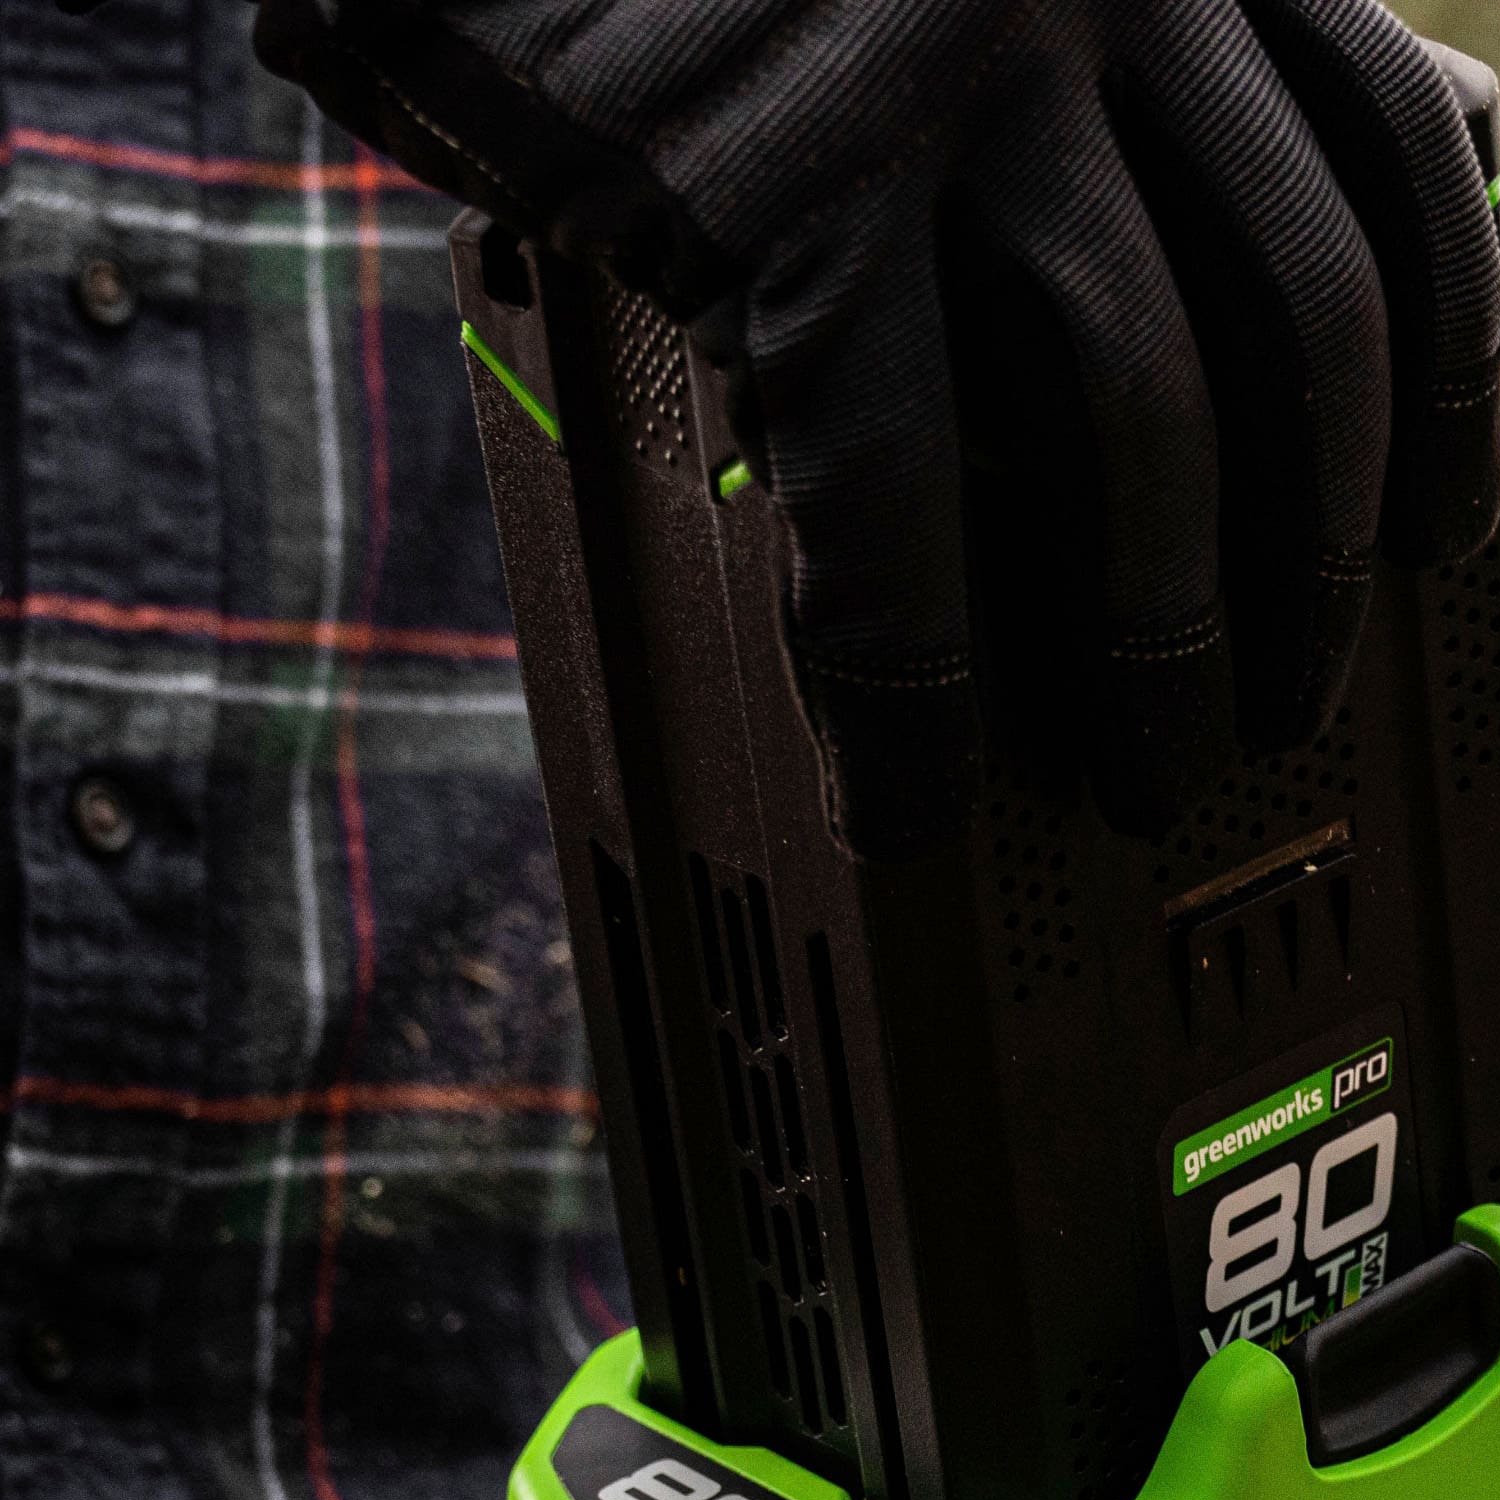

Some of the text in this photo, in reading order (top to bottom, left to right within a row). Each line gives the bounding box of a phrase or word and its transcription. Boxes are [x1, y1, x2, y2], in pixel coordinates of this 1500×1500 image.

[1184, 1050, 1388, 1184] greenworks pro
[1205, 1112, 1398, 1314] 80
[1199, 1249, 1356, 1357] VOLT
